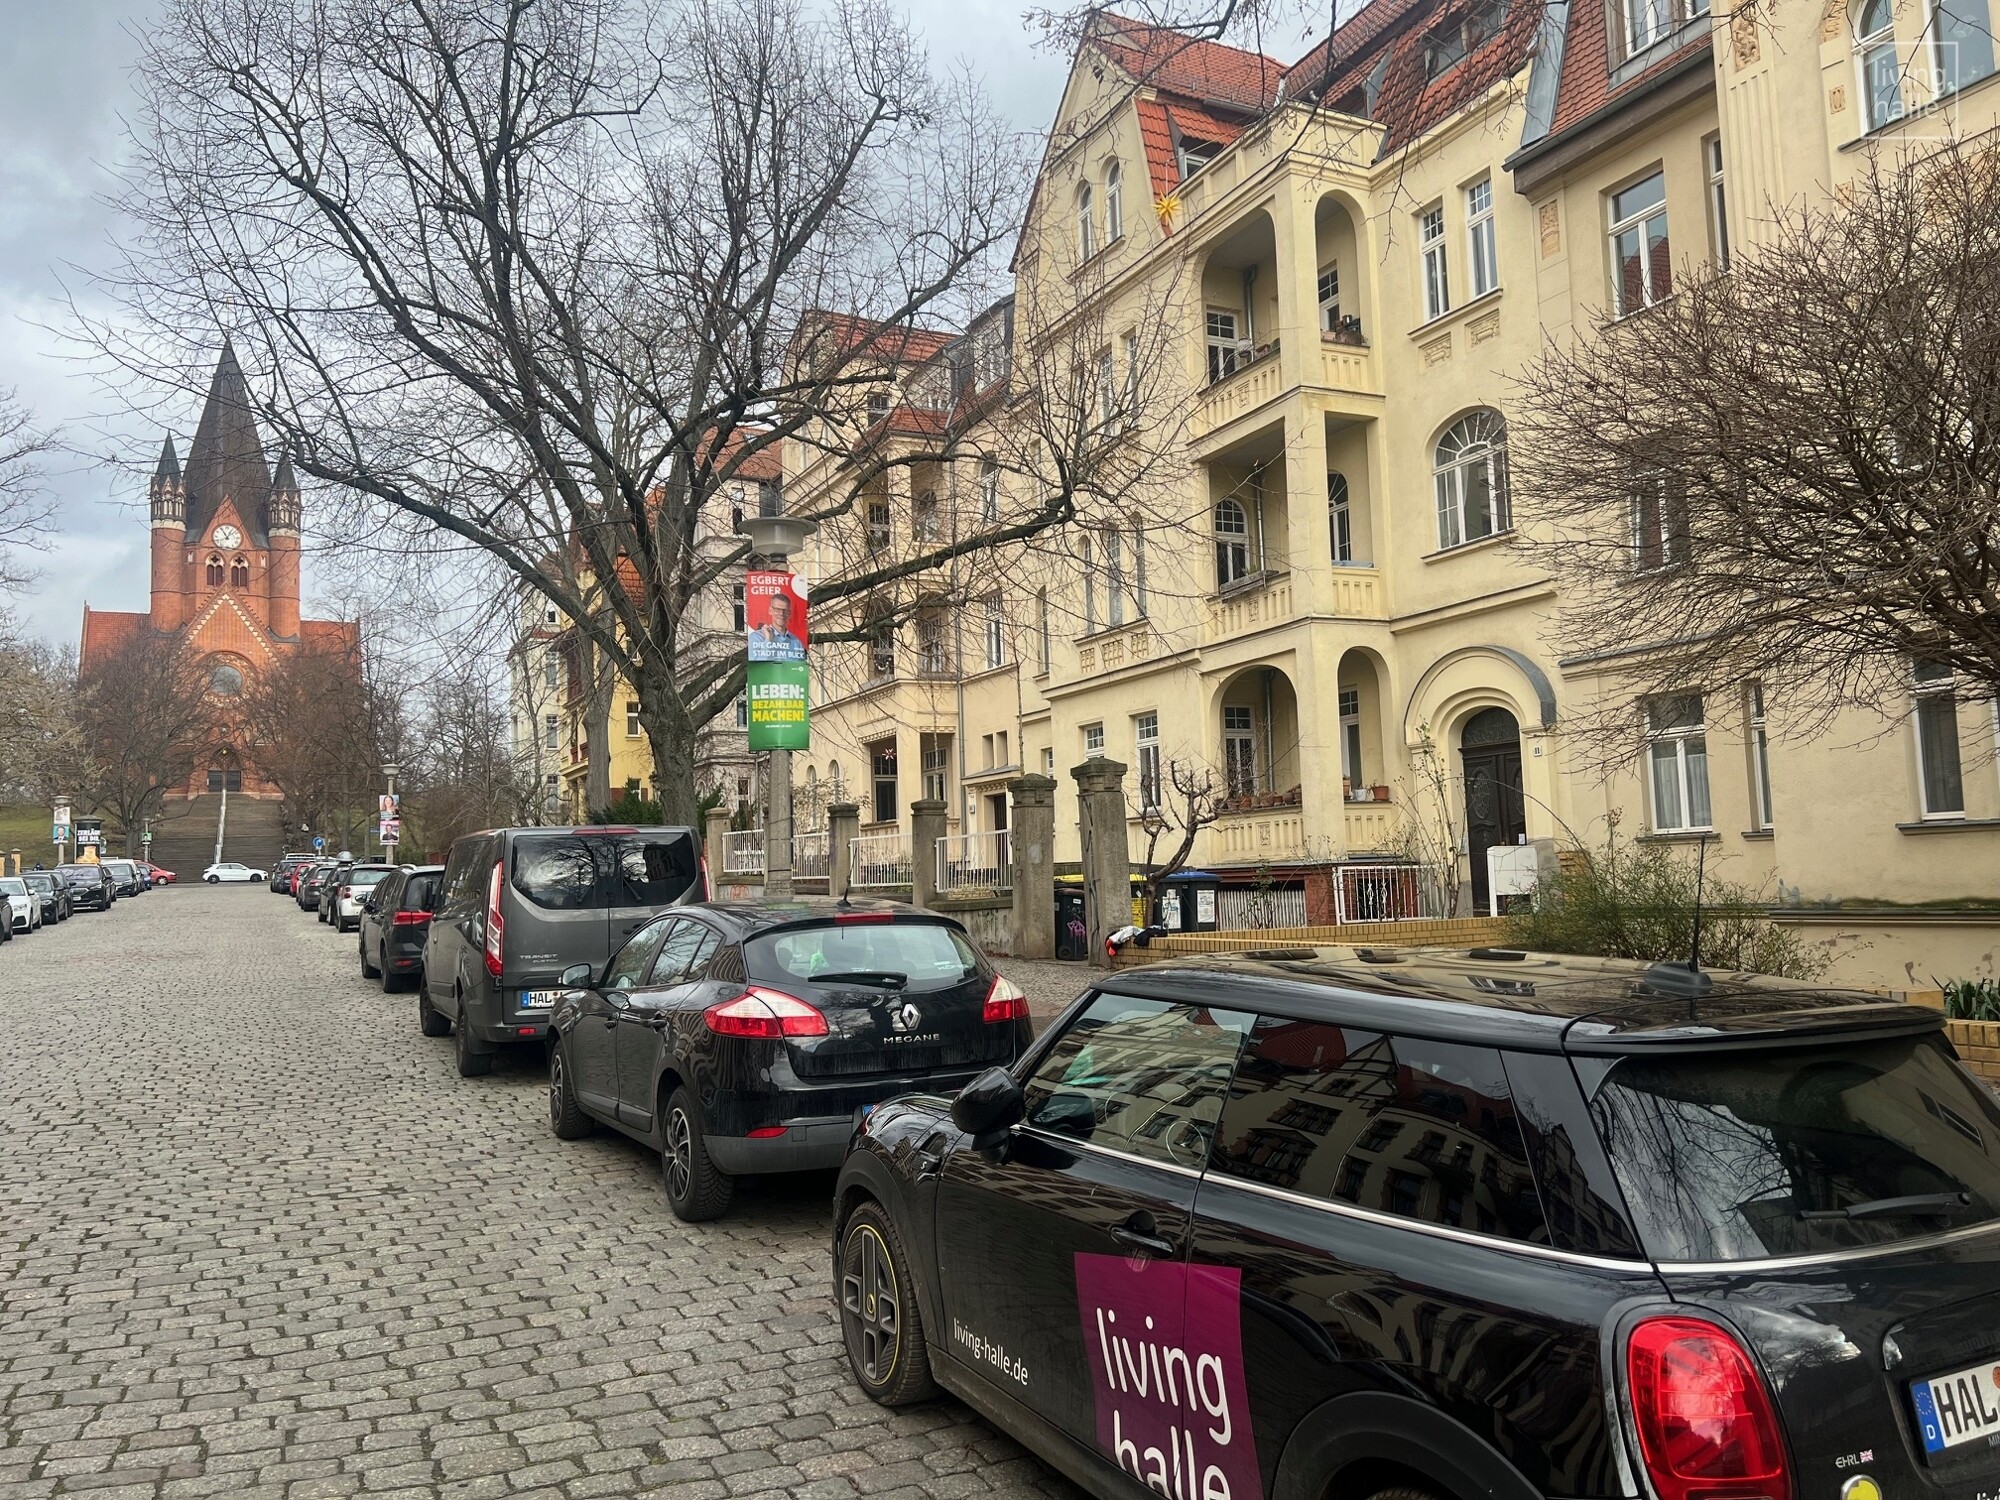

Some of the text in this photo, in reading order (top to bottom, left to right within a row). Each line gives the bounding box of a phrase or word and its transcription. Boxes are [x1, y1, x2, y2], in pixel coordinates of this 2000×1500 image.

[750, 575, 790, 586] EGBERT
[751, 585, 781, 595] GEIER
[752, 641, 790, 650] DIE GANZE
[777, 650, 787, 658] IM
[751, 684, 805, 700] LEBEN:
[752, 700, 805, 710] BEZAHLBAR
[752, 709, 805, 722] MACHEN!
[529, 992, 552, 1004] HAL
[883, 1033, 941, 1045] MEGANE
[953, 1317, 1028, 1386] living-halle.de
[1096, 1307, 1232, 1446] living
[1933, 1374, 1998, 1438] HAL
[1926, 1424, 1936, 1440] D
